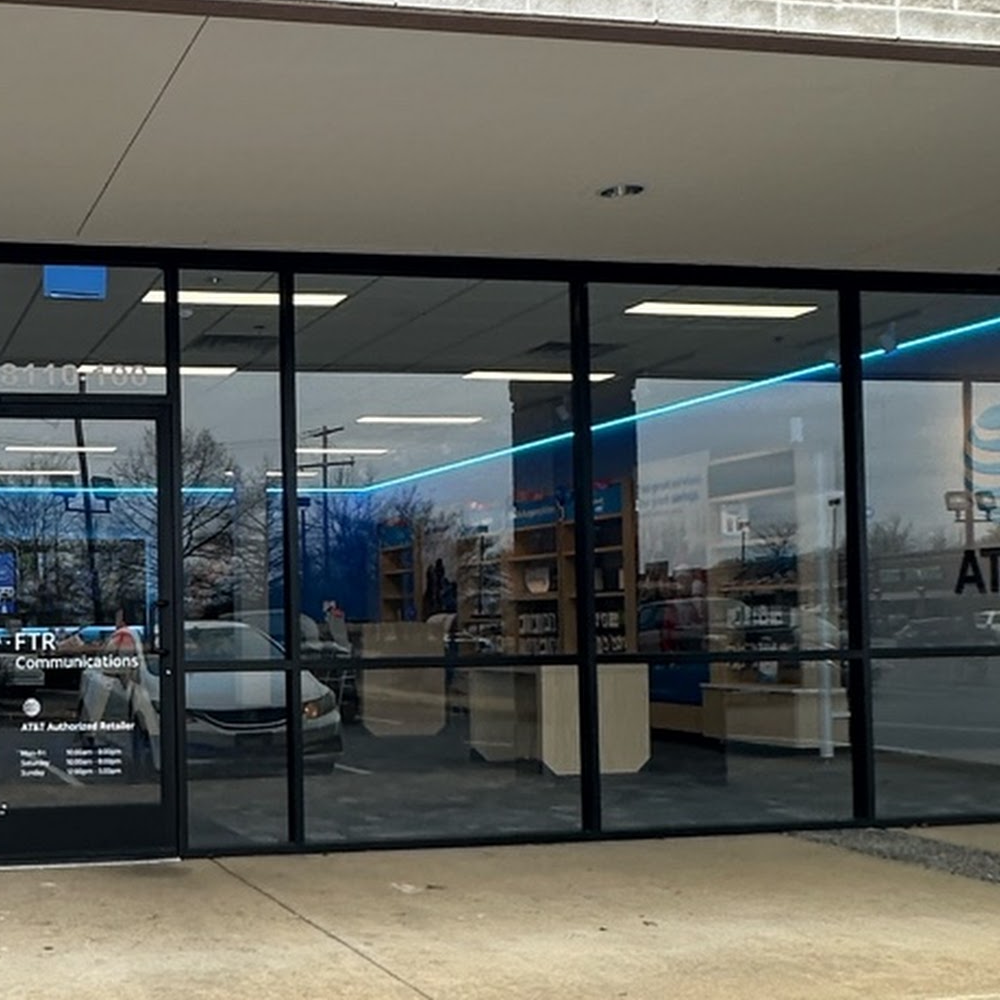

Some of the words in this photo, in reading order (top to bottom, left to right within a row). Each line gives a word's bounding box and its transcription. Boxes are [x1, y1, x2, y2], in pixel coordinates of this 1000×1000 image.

[15, 632, 56, 651] FTR
[15, 654, 139, 671] Communications
[20, 721, 45, 732] AT&T
[47, 721, 98, 732] Authorized
[100, 721, 136, 732] Retailer
